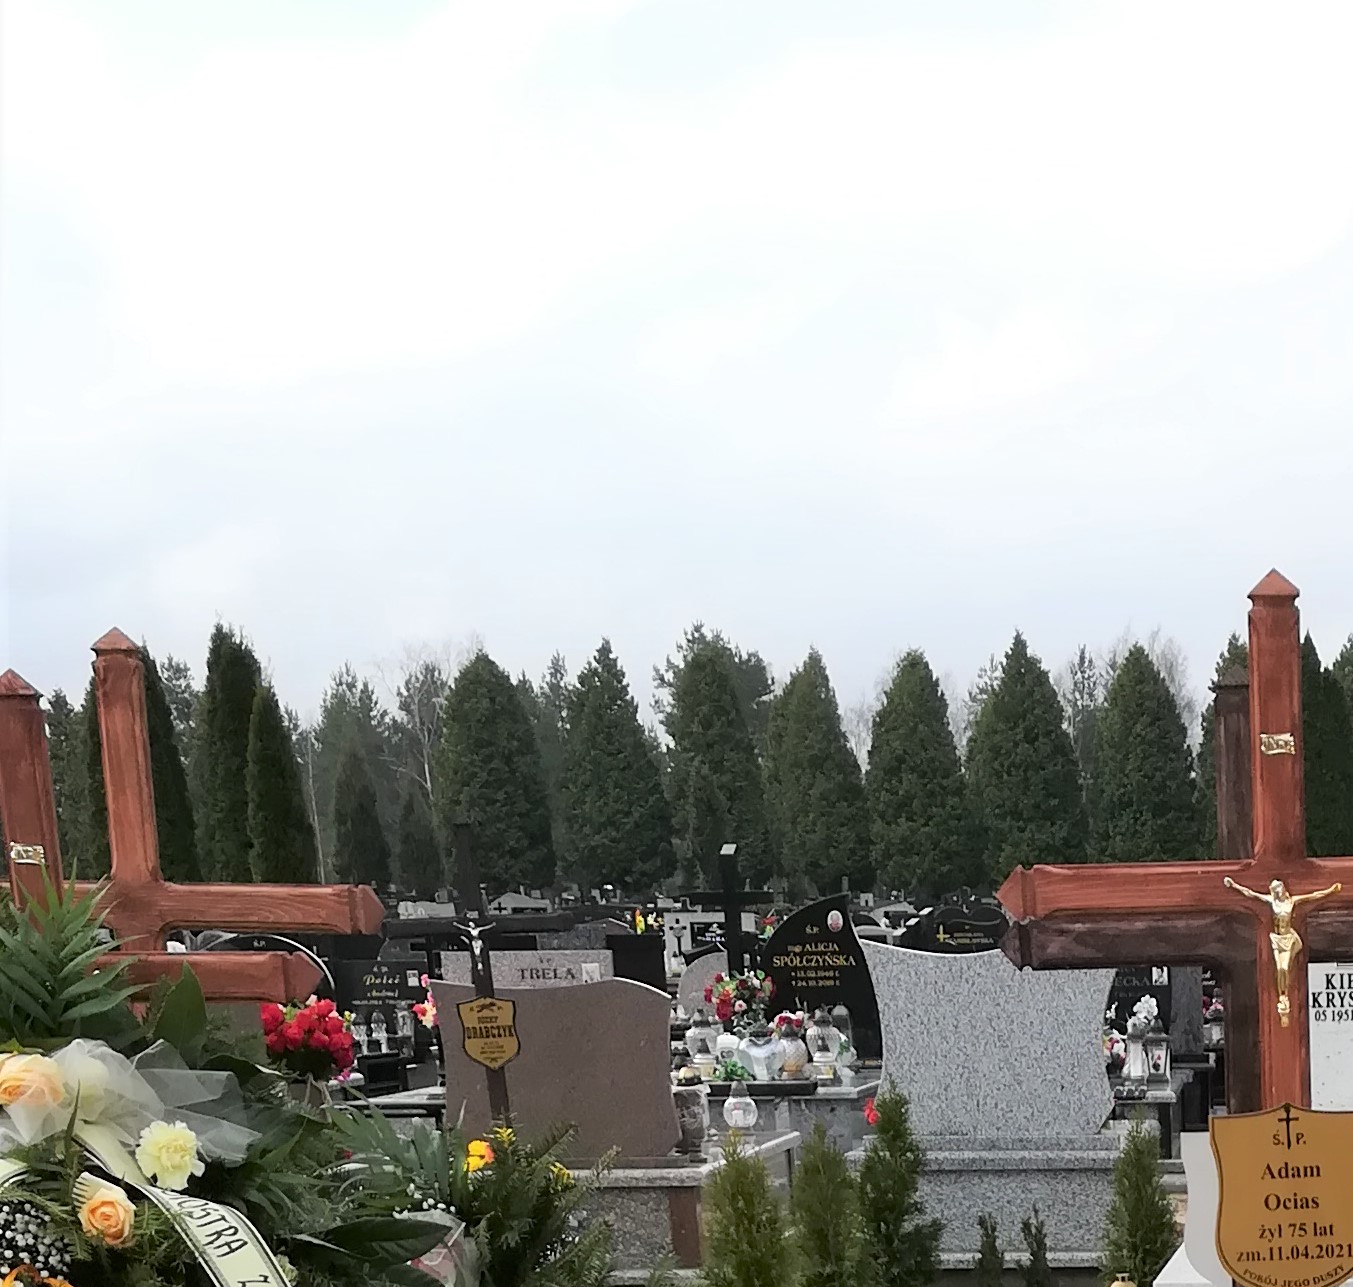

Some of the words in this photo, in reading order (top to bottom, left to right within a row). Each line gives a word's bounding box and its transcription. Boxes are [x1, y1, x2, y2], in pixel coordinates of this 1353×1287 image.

[519, 967, 577, 980] TRELA
[1314, 1009, 1327, 1021] 05
[1296, 1132, 1307, 1145] P.
[1261, 1162, 1322, 1180] Adam
[1263, 1192, 1320, 1211] Ocias
[1288, 1222, 1308, 1238] 75
[1313, 1221, 1334, 1237] lat
[1236, 1243, 1353, 1262] zm.11.04.2021
[1243, 1268, 1279, 1287] POKÓJ
[1281, 1278, 1310, 1287] JEGO
[1313, 1264, 1345, 1284] DUSZY
